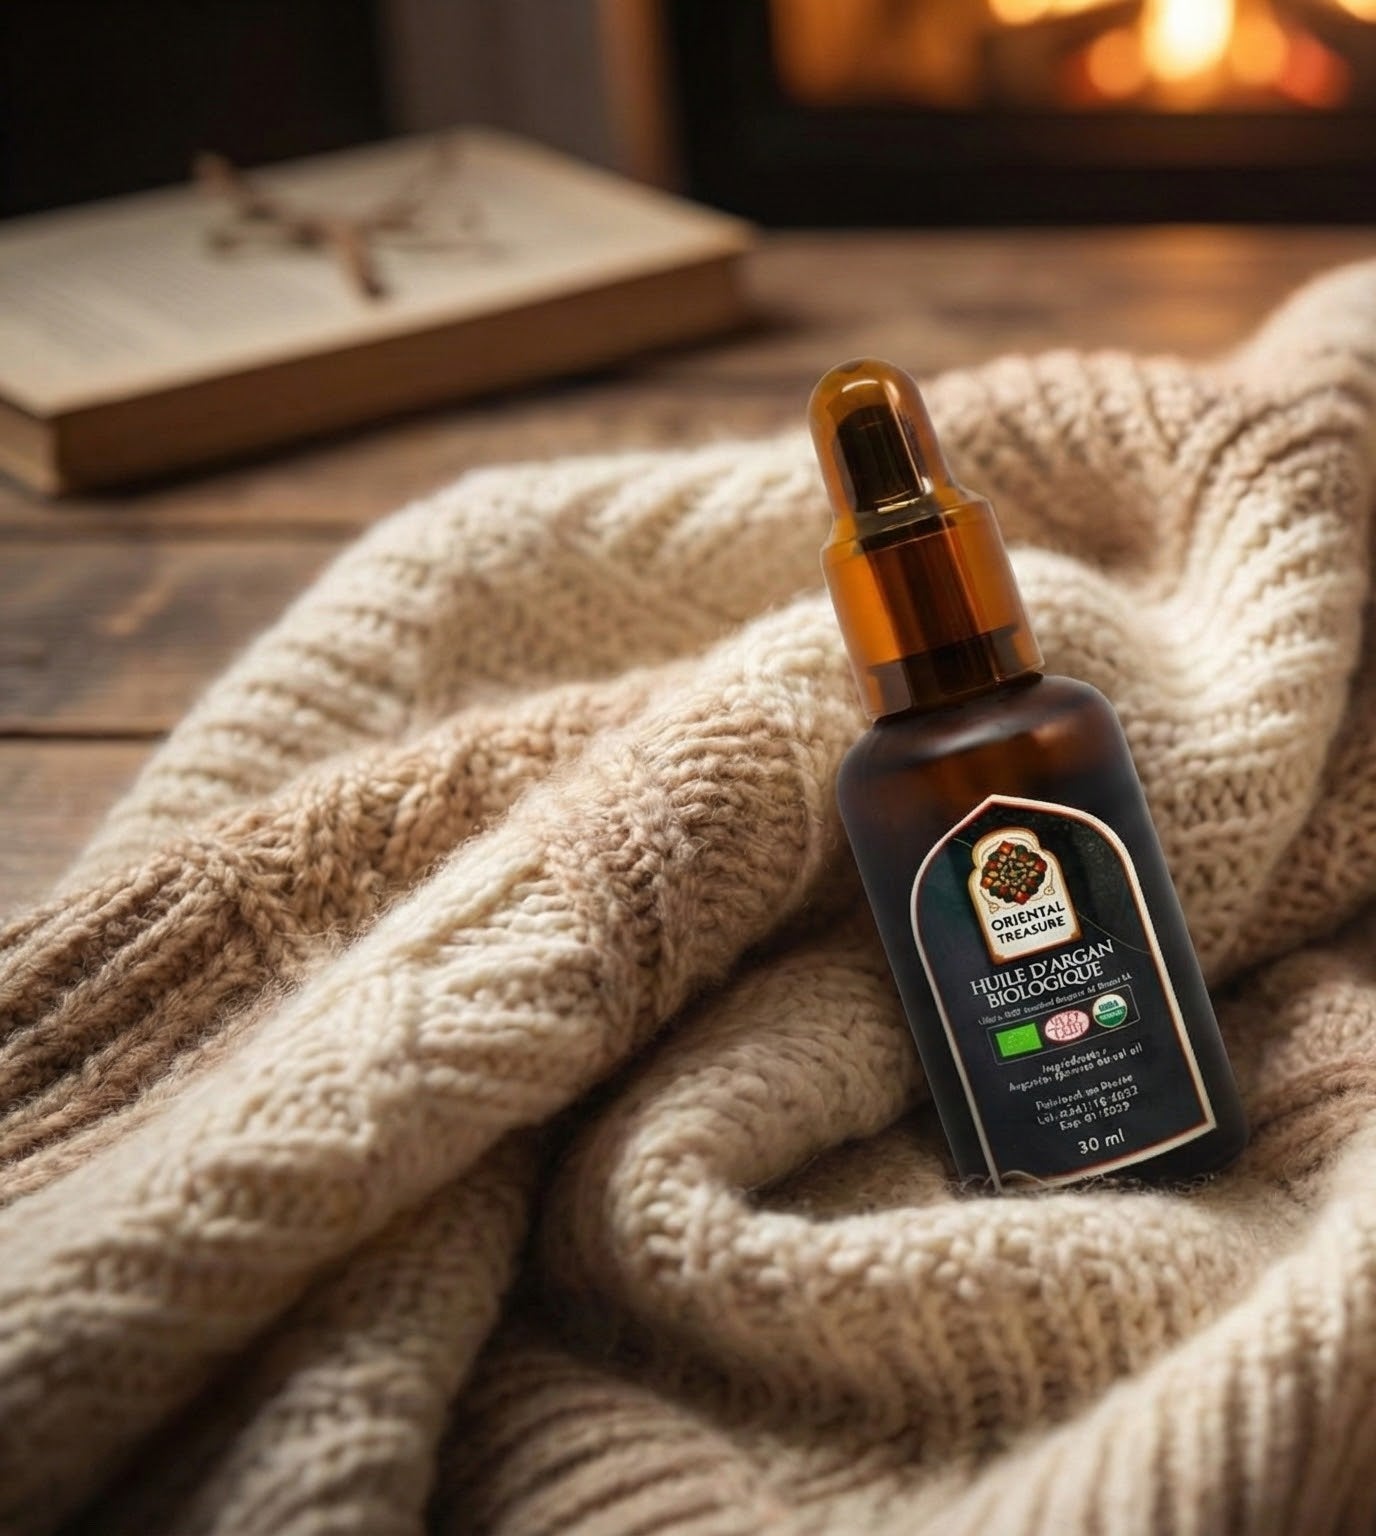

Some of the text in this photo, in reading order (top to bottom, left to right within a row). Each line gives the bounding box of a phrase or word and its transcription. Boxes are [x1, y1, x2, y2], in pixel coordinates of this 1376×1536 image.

[991, 901, 1066, 931] ORIENTAL
[997, 915, 1066, 944] TREASURE
[970, 938, 1114, 996] HUILE D'ARGAN
[986, 961, 1104, 1009] BIOLOGIQUE
[1077, 1128, 1126, 1155] 30 ml
